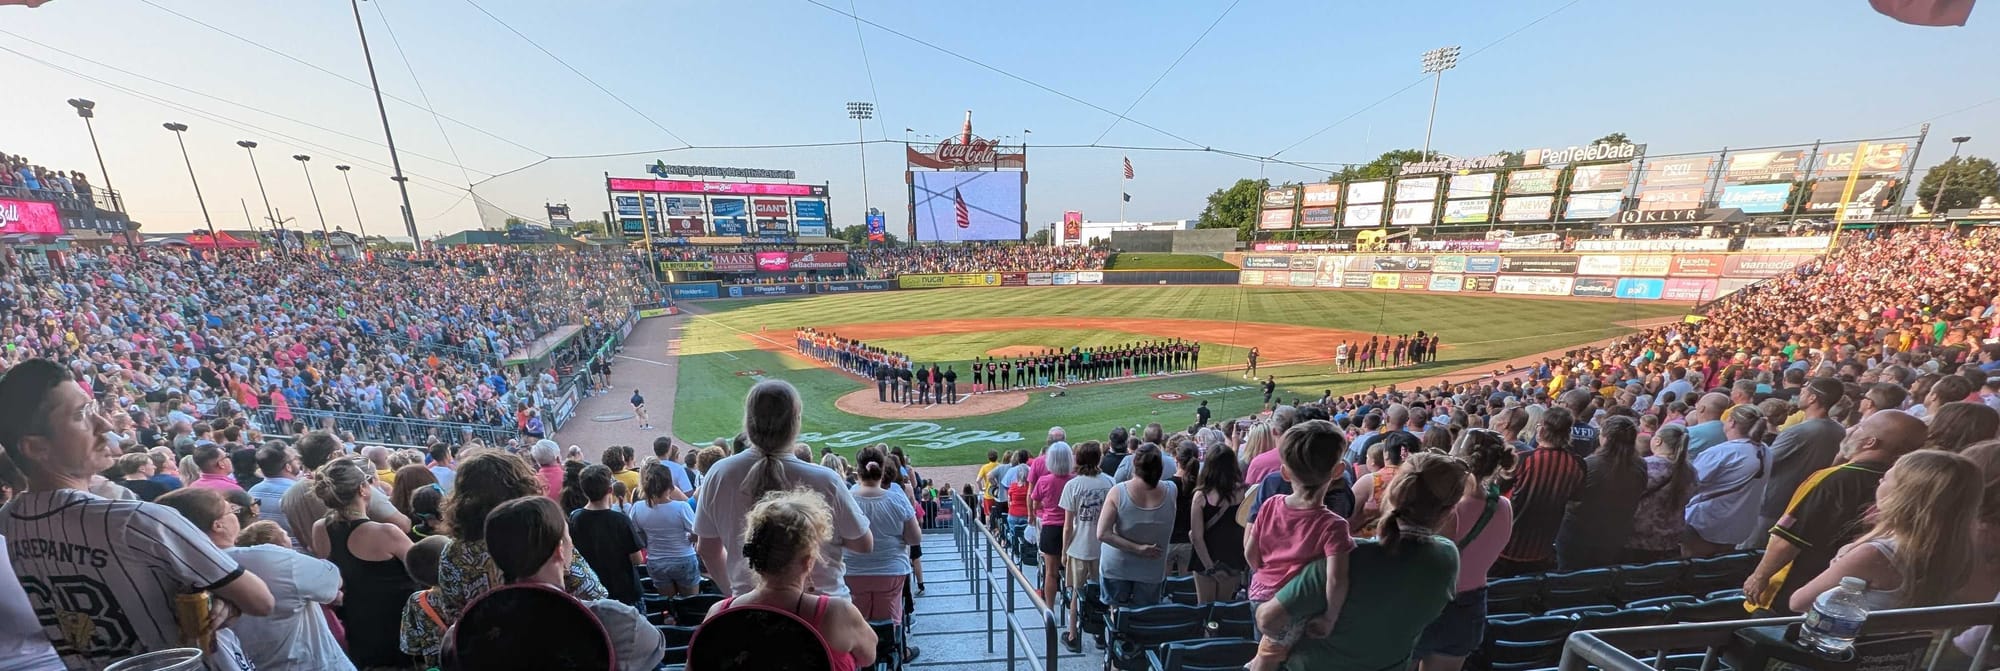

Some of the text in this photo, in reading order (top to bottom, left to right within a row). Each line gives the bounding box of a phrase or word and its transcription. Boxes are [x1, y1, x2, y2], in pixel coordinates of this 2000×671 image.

[756, 204, 786, 212] GIANT
[1646, 209, 1696, 221] KLYR
[1740, 259, 1794, 269] viamedia
[921, 275, 944, 283] nucar
